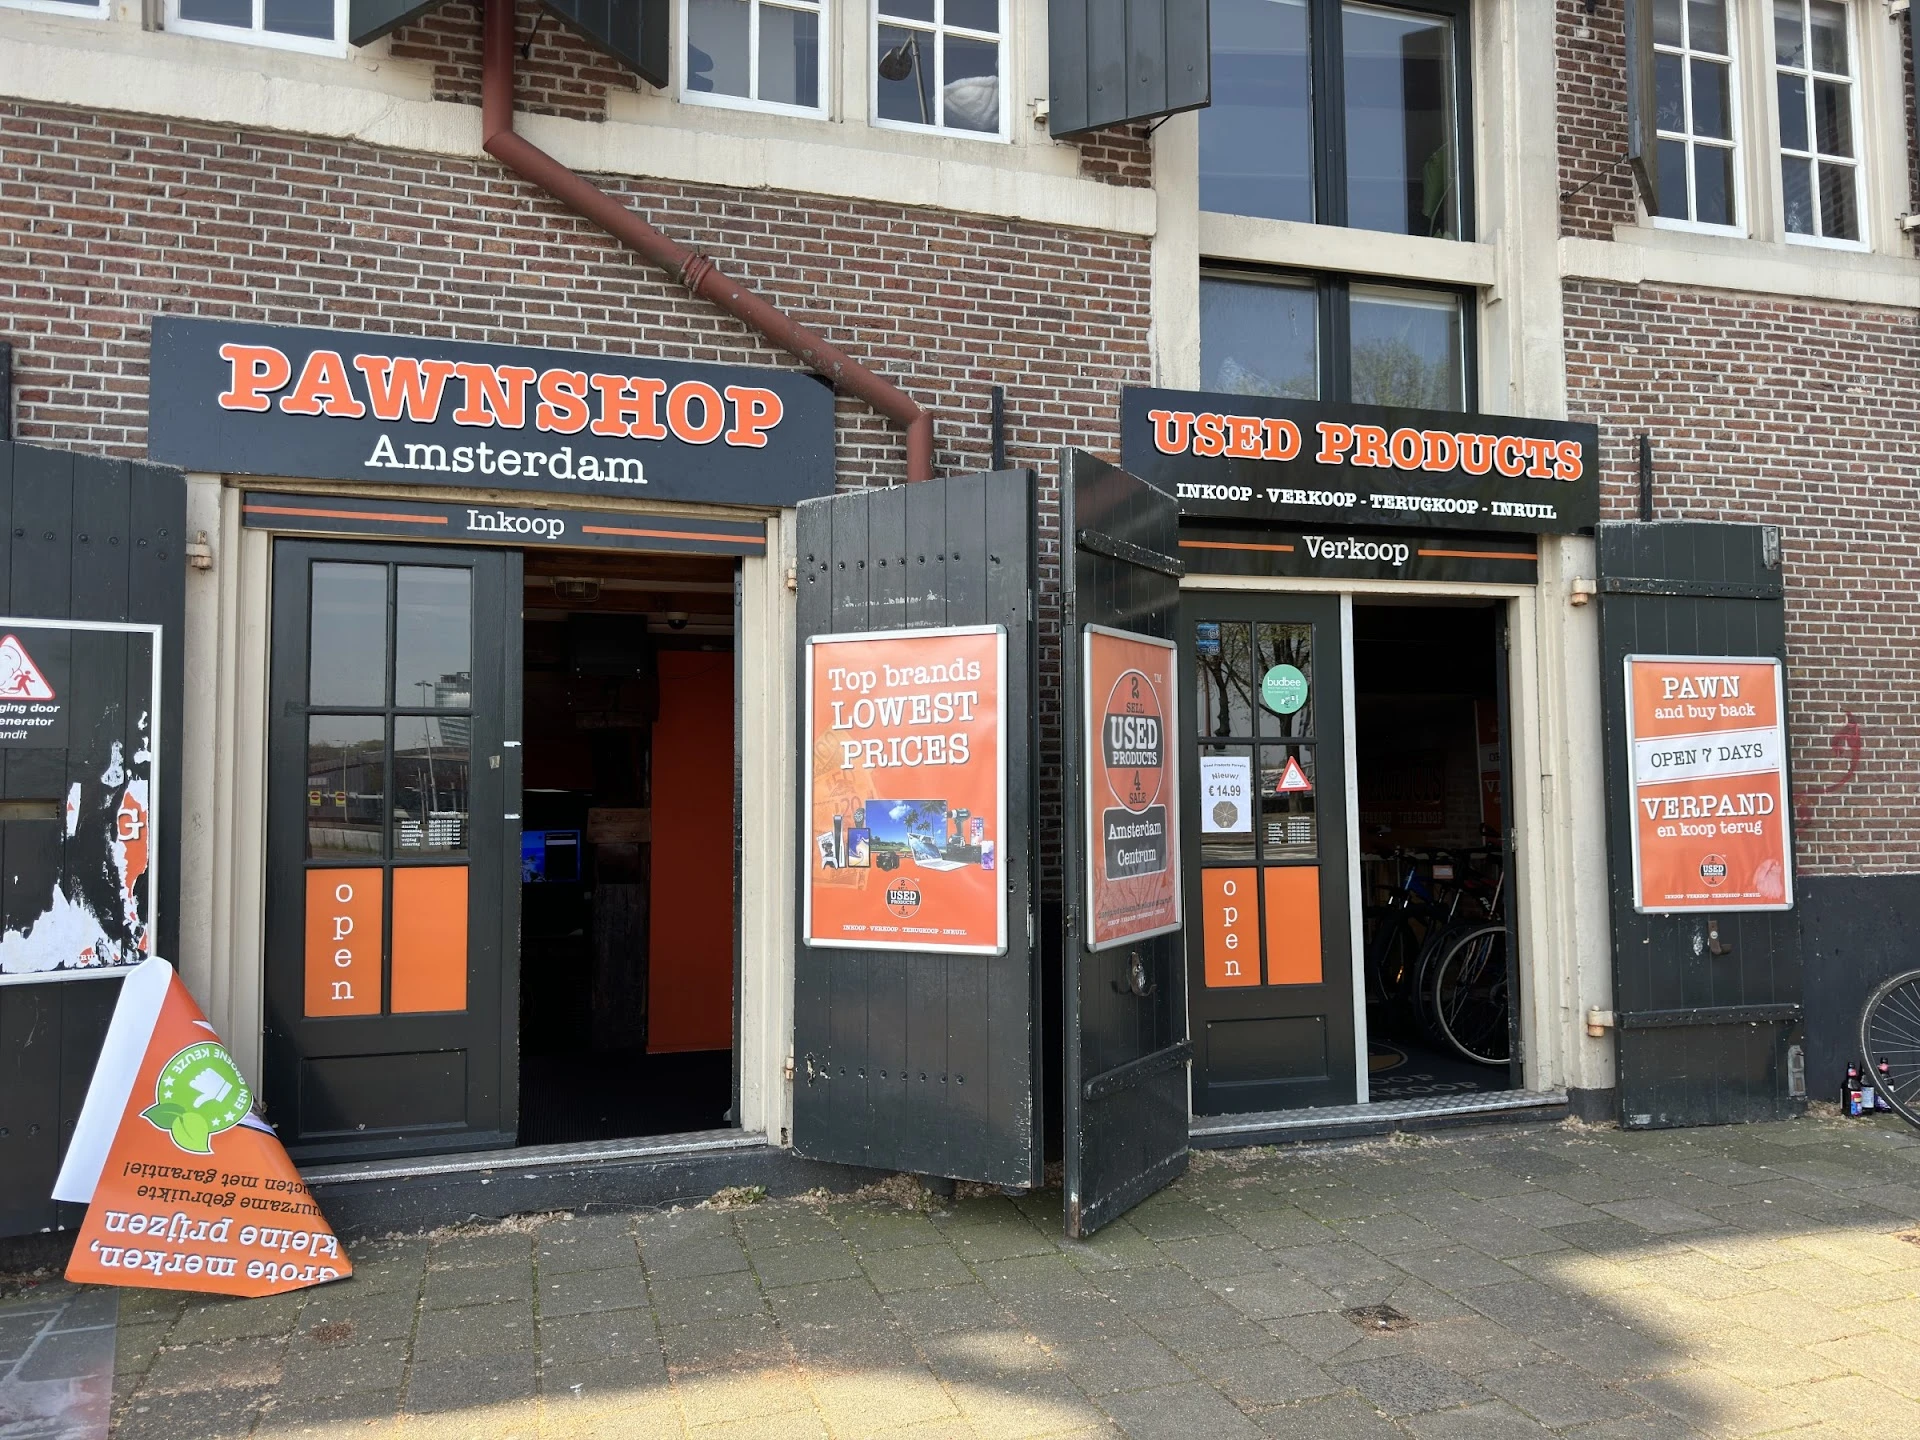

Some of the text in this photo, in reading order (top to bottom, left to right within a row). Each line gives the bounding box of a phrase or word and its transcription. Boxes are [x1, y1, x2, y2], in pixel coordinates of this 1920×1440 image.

[218, 343, 784, 448] PAWNSHOP
[1147, 409, 1584, 482] USED PRODUCTS
[364, 434, 648, 485] Amsterdam
[1176, 482, 1253, 502] INKOOP
[1266, 488, 1357, 508] VERKOOP
[1370, 494, 1479, 515] TERUGKOOP
[1491, 502, 1557, 520] INRUIL
[466, 509, 565, 539] Inkoop
[1302, 535, 1409, 566] Verkoop
[828, 658, 981, 695] Top brands
[1131, 677, 1139, 699] 2
[1267, 676, 1301, 687] budbee
[1661, 675, 1740, 700] PAWN
[30, 703, 60, 713] door
[831, 690, 978, 730] LOWEST
[1126, 702, 1144, 714] SELL
[1654, 702, 1756, 721] and buy back
[1111, 716, 1157, 750] USED
[840, 732, 970, 770] PRICES
[1112, 751, 1157, 765] PRODUCTS
[1651, 743, 1764, 768] OPEN 7 DAYS
[1134, 770, 1140, 790] 4
[1209, 785, 1241, 797] € 14.99
[1129, 792, 1146, 804] SALE
[1640, 792, 1775, 821] VERPAND
[1108, 820, 1162, 841] Amsterdam
[1657, 820, 1763, 839] en koop terug
[1117, 848, 1156, 867] Centrum
[1703, 864, 1724, 872] USED
[890, 891, 917, 900] USED
[1223, 880, 1241, 976] open
[331, 883, 354, 1000] open
[172, 1047, 210, 1074] KEUZE
[234, 1088, 248, 1110] EEN
[123, 1162, 217, 1184] garantie!
[221, 1173, 259, 1188] met
[137, 1185, 236, 1207] gebruikte
[105, 1210, 339, 1259] kleine prijzen
[90, 1240, 238, 1276] merken,
